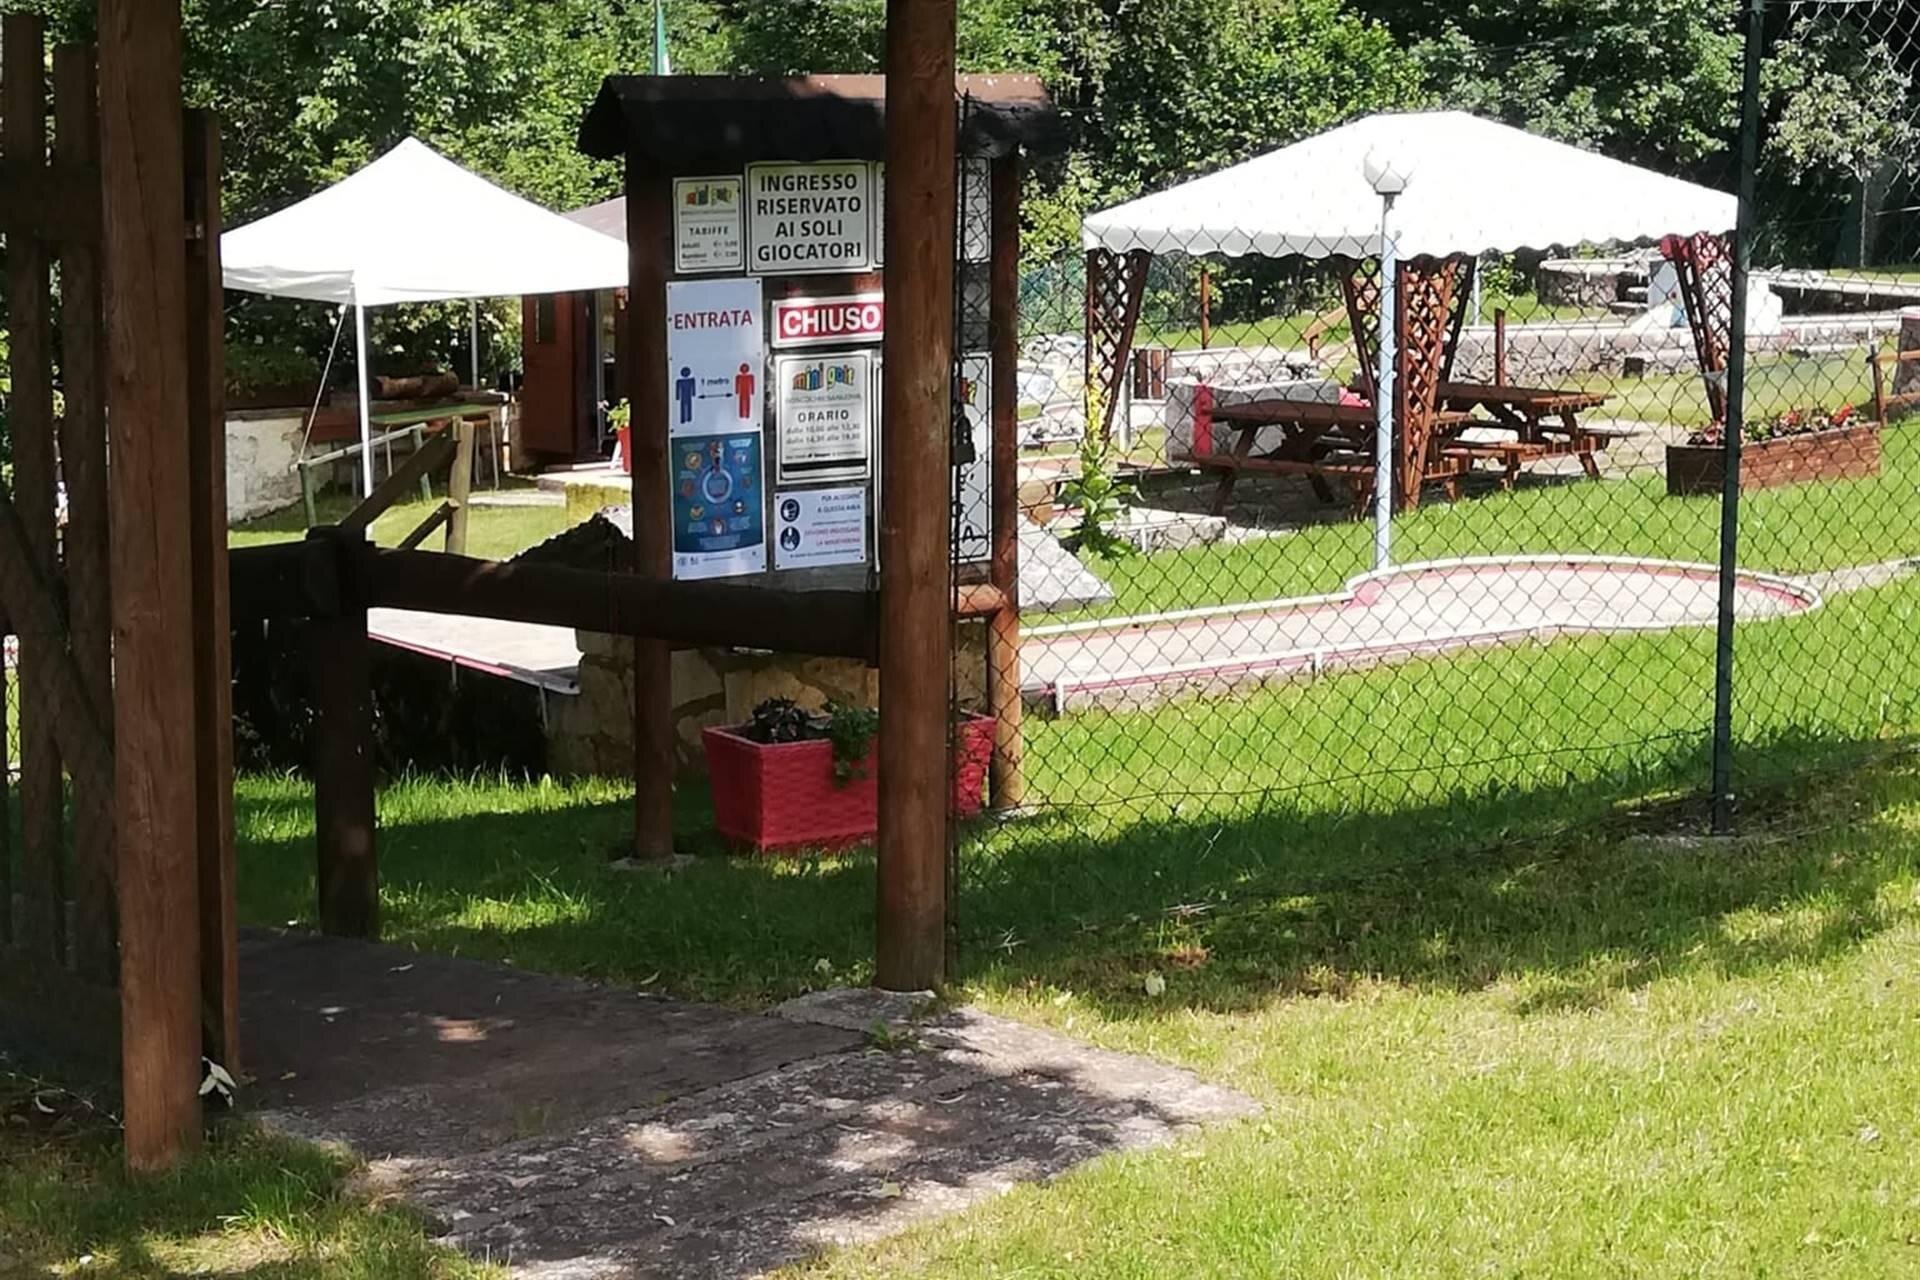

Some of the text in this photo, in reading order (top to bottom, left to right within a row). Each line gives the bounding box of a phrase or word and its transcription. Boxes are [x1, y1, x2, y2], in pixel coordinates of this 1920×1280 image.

[761, 173, 858, 192] INGRESSO
[757, 196, 861, 216] RISERVATO
[689, 226, 728, 236] TARIFFE
[775, 219, 842, 238] AI SOLI
[758, 242, 861, 262] GIOCATORI
[674, 309, 753, 330] ENTRATA
[783, 304, 881, 336] CHIUSO
[701, 374, 730, 386] 1 metro
[792, 362, 824, 391] mini
[797, 408, 849, 423] ORARIO
